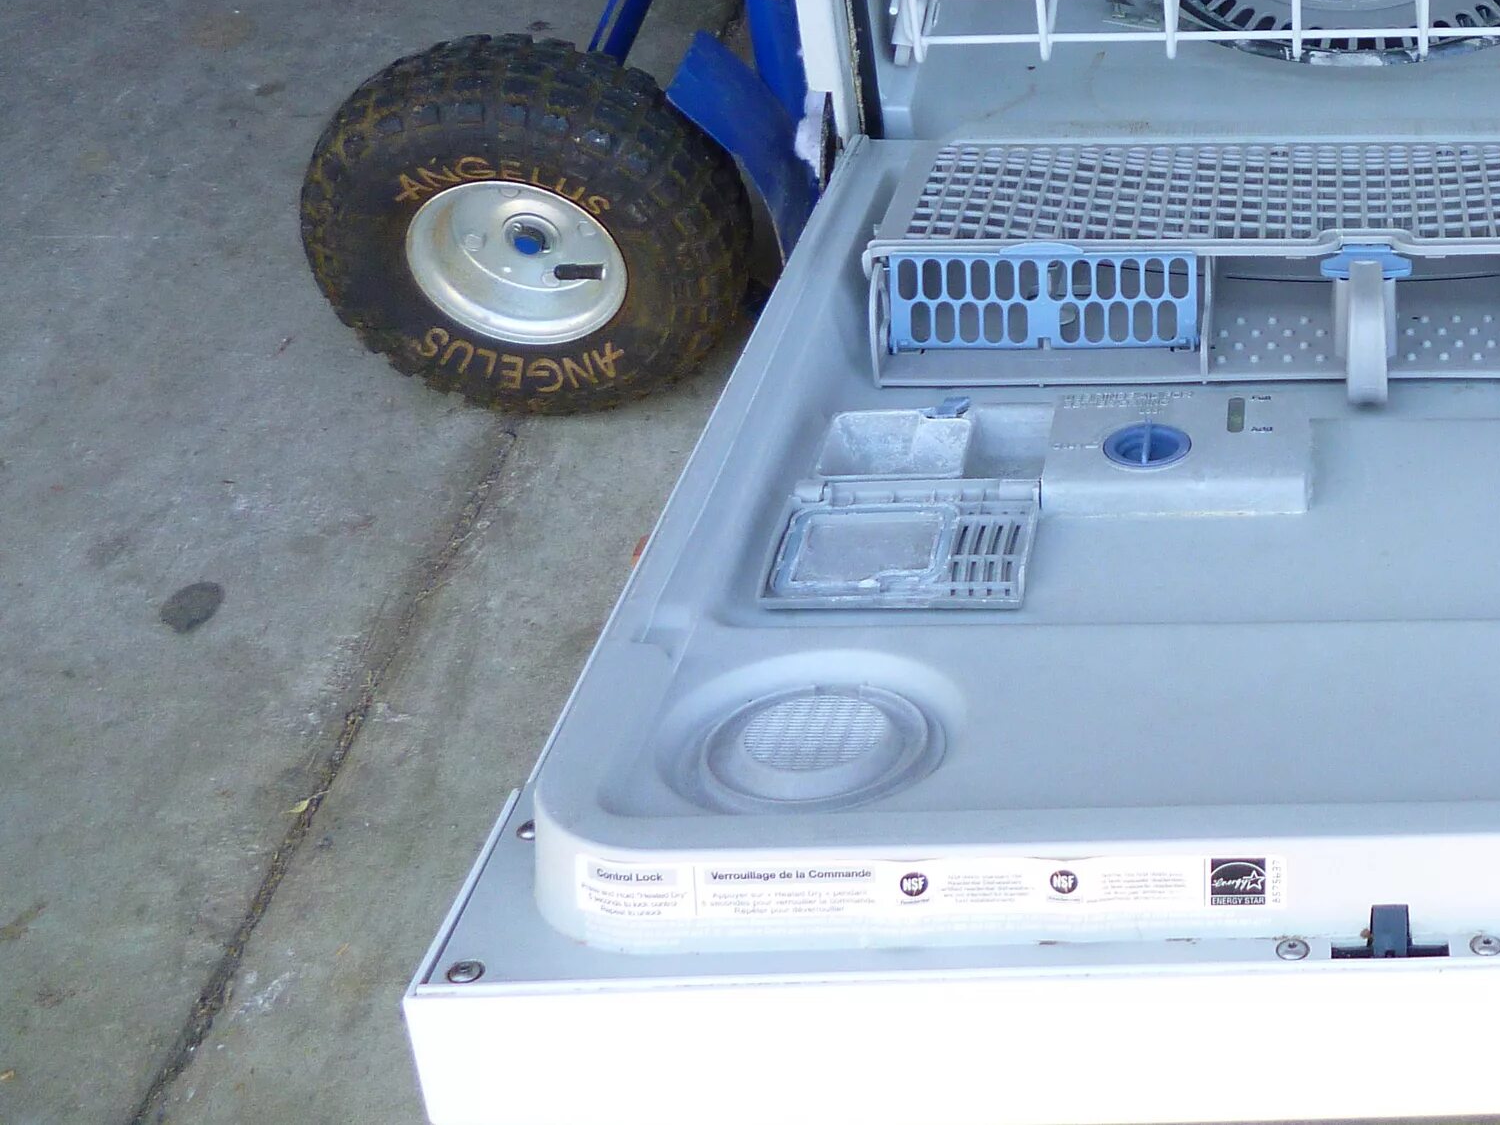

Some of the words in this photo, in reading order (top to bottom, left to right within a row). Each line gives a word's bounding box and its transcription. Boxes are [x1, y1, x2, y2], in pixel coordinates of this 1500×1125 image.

[395, 156, 611, 215] ANGELUS
[416, 326, 625, 393] ANGELUS
[596, 868, 633, 882] Control
[636, 872, 664, 882] Lock
[711, 870, 777, 882] Verrouillage
[779, 869, 793, 880] de
[796, 869, 806, 879] la
[808, 868, 872, 880] Commande
[1052, 875, 1075, 889] NSF
[902, 876, 925, 892] NSF
[1212, 897, 1243, 906] ENERGY
[1244, 897, 1265, 905] STAR
